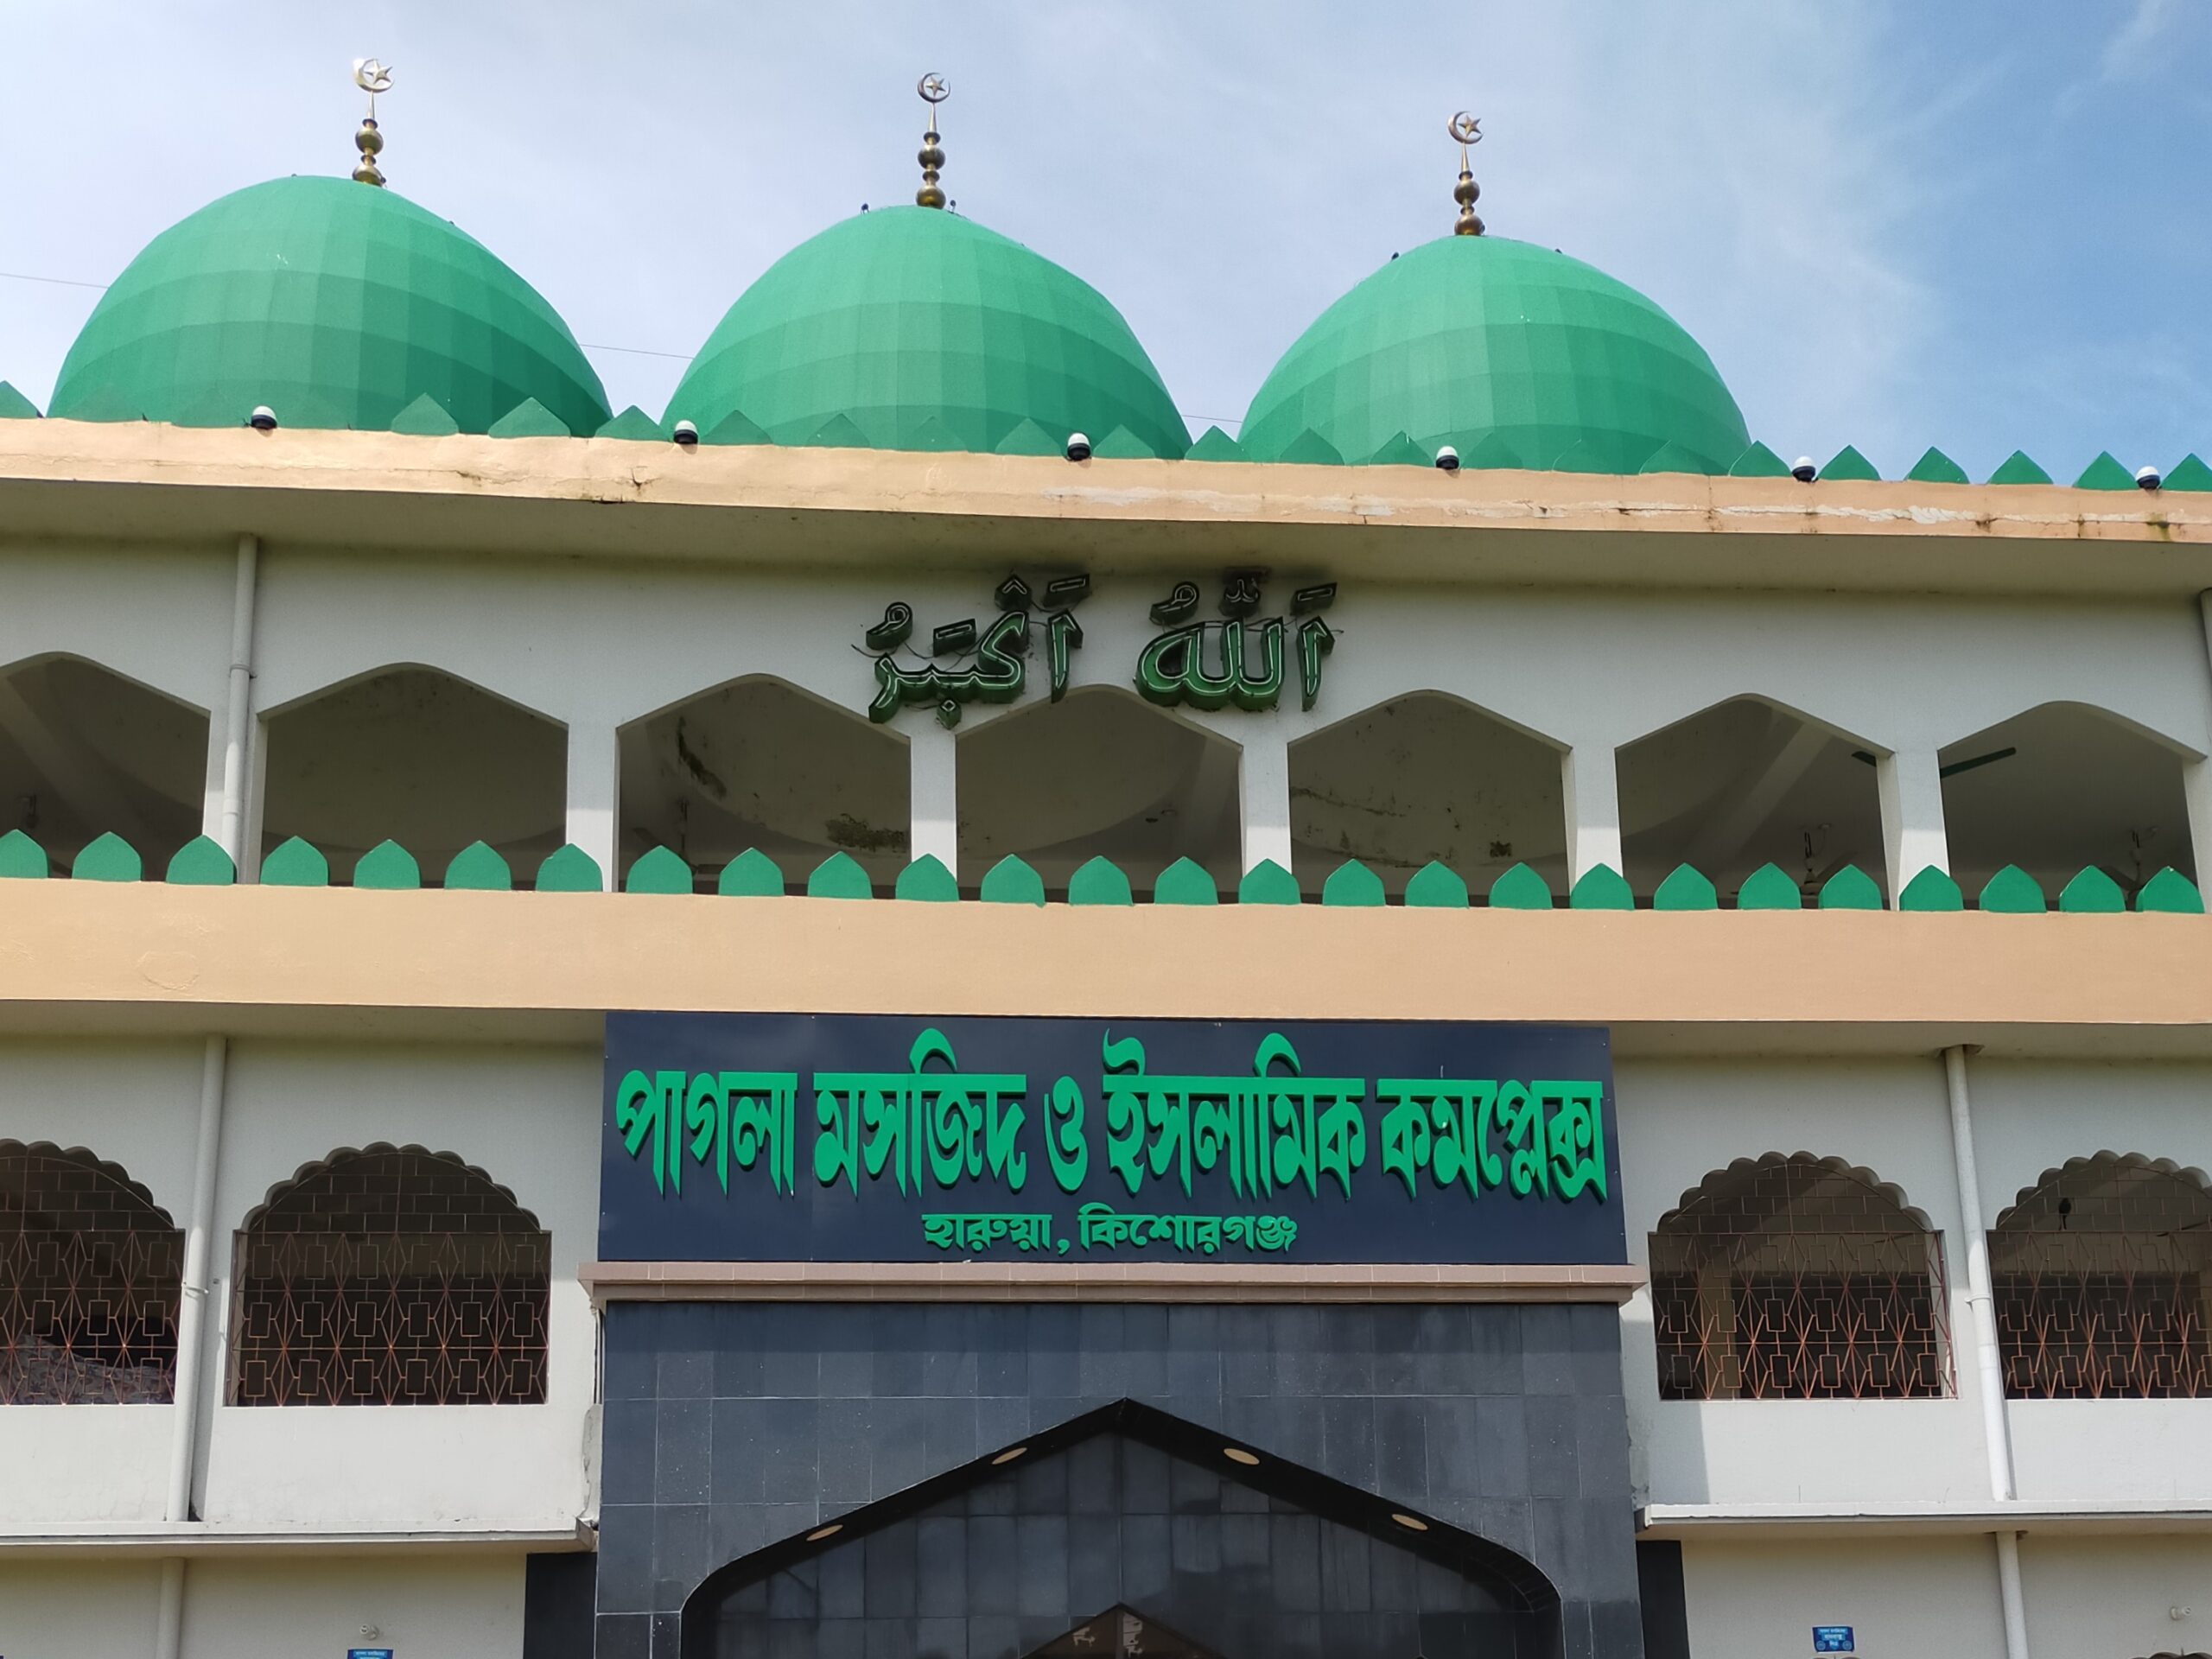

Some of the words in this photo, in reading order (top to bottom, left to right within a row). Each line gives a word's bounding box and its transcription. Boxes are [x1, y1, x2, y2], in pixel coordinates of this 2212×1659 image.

[616, 1070, 798, 1196] পাগলা
[813, 1028, 1027, 1198] মসজিদ
[1044, 1076, 1089, 1192] ও
[1102, 1028, 1366, 1199] ইসলামিক
[1376, 1078, 1608, 1202] কমপ্লেক্স
[1077, 1202, 1298, 1255] কিশোরগঞ্জ
